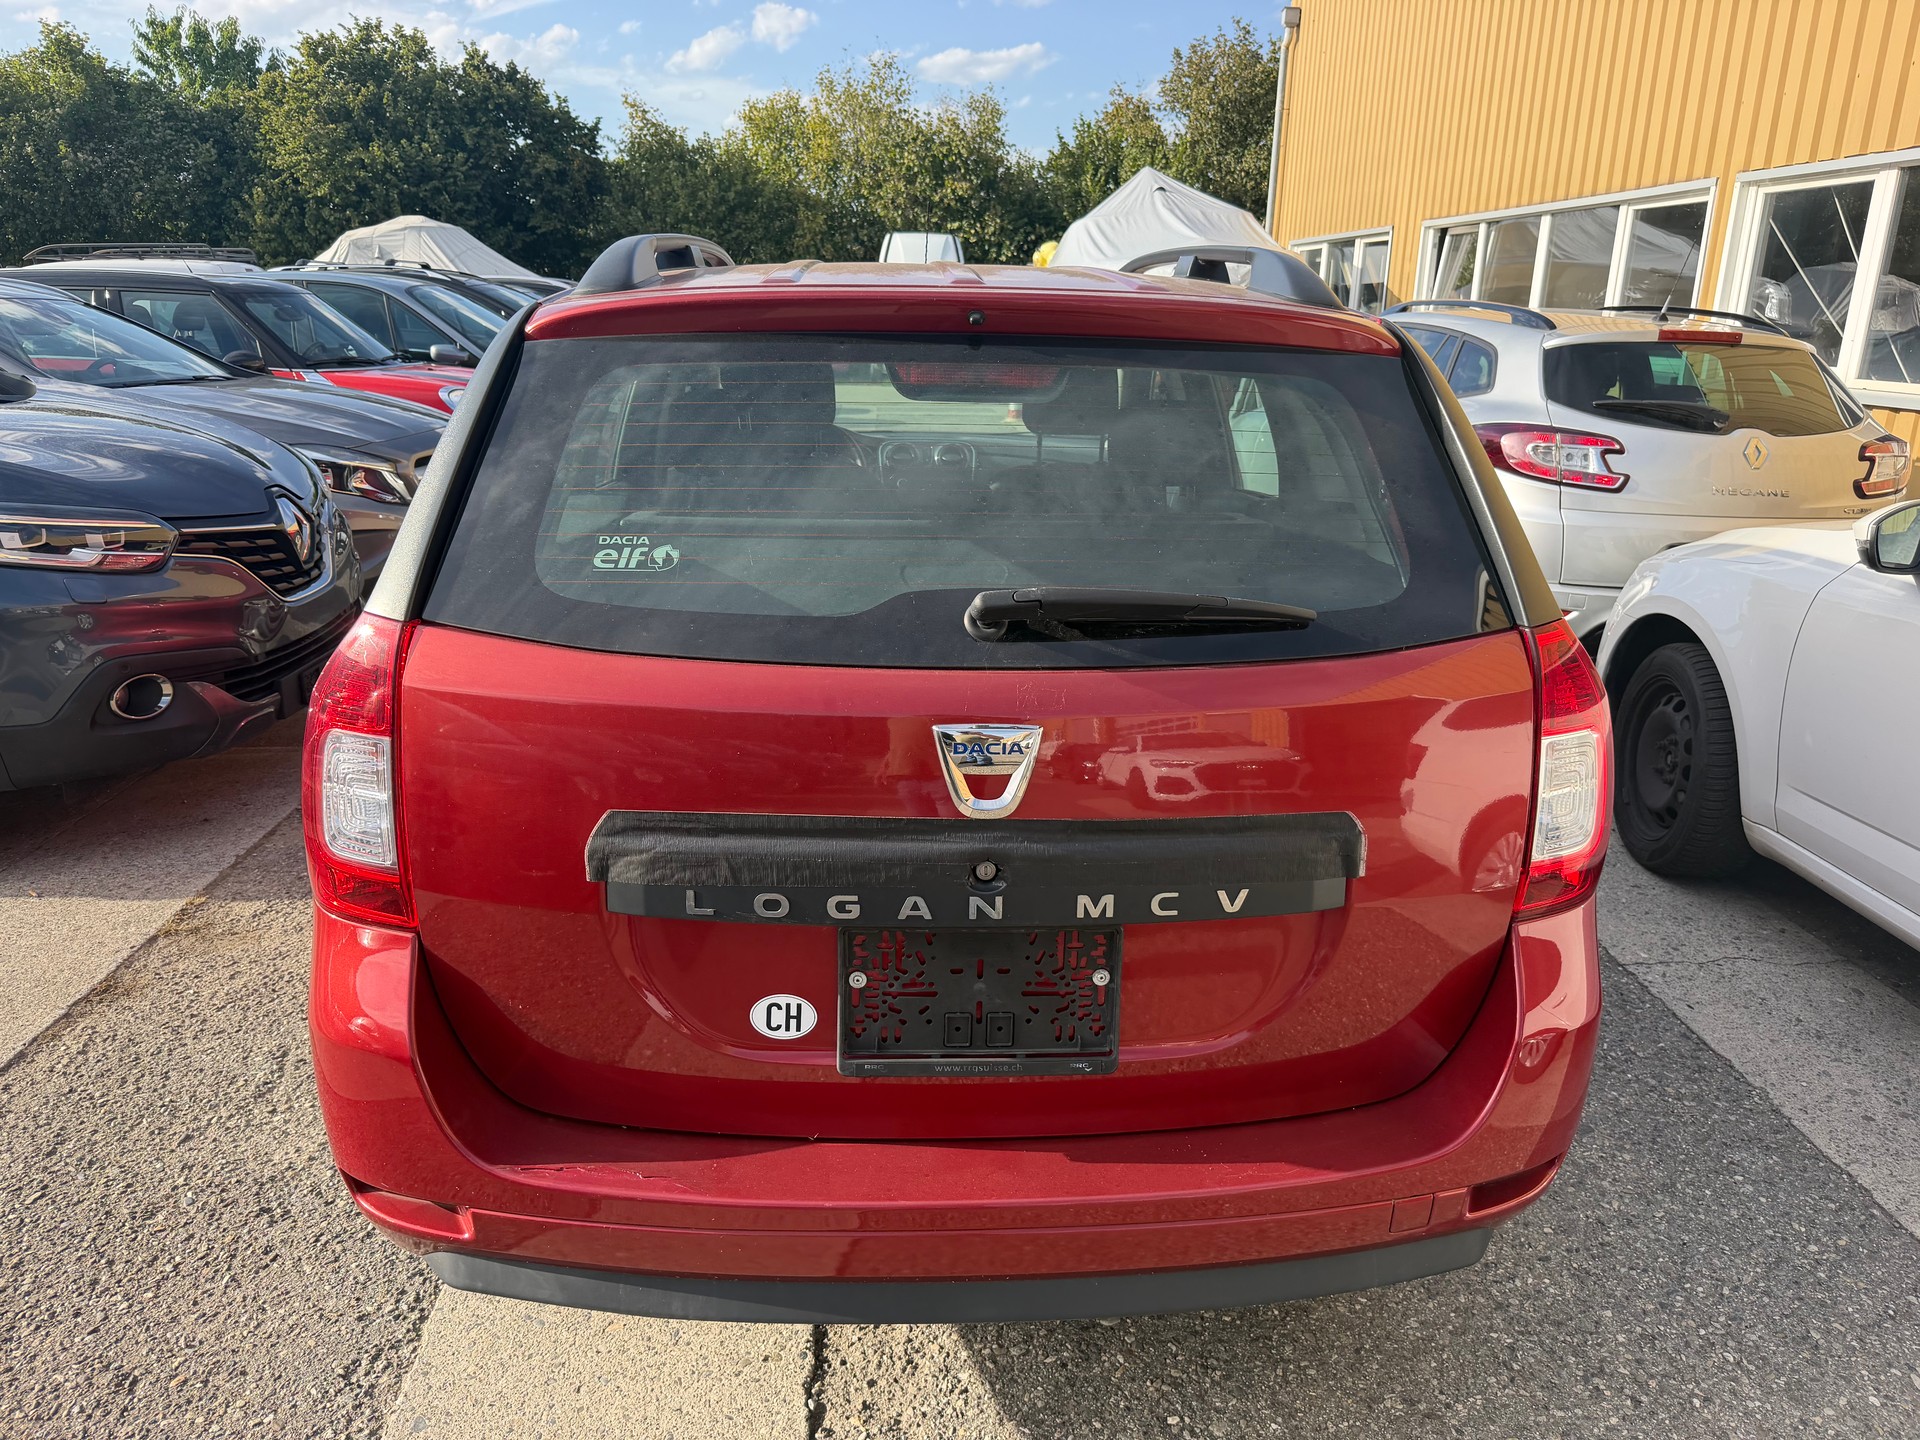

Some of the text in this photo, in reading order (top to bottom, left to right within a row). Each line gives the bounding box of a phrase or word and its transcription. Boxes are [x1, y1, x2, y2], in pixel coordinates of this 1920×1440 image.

[1711, 486, 1790, 498] MEGANE
[598, 536, 650, 545] DACIA
[593, 547, 649, 569] elf
[952, 742, 1025, 756] DACIA
[685, 888, 1250, 920] LOGAN MCV
[766, 1002, 802, 1032] CH
[934, 1063, 1023, 1073] www.rrgsuisse.ch
